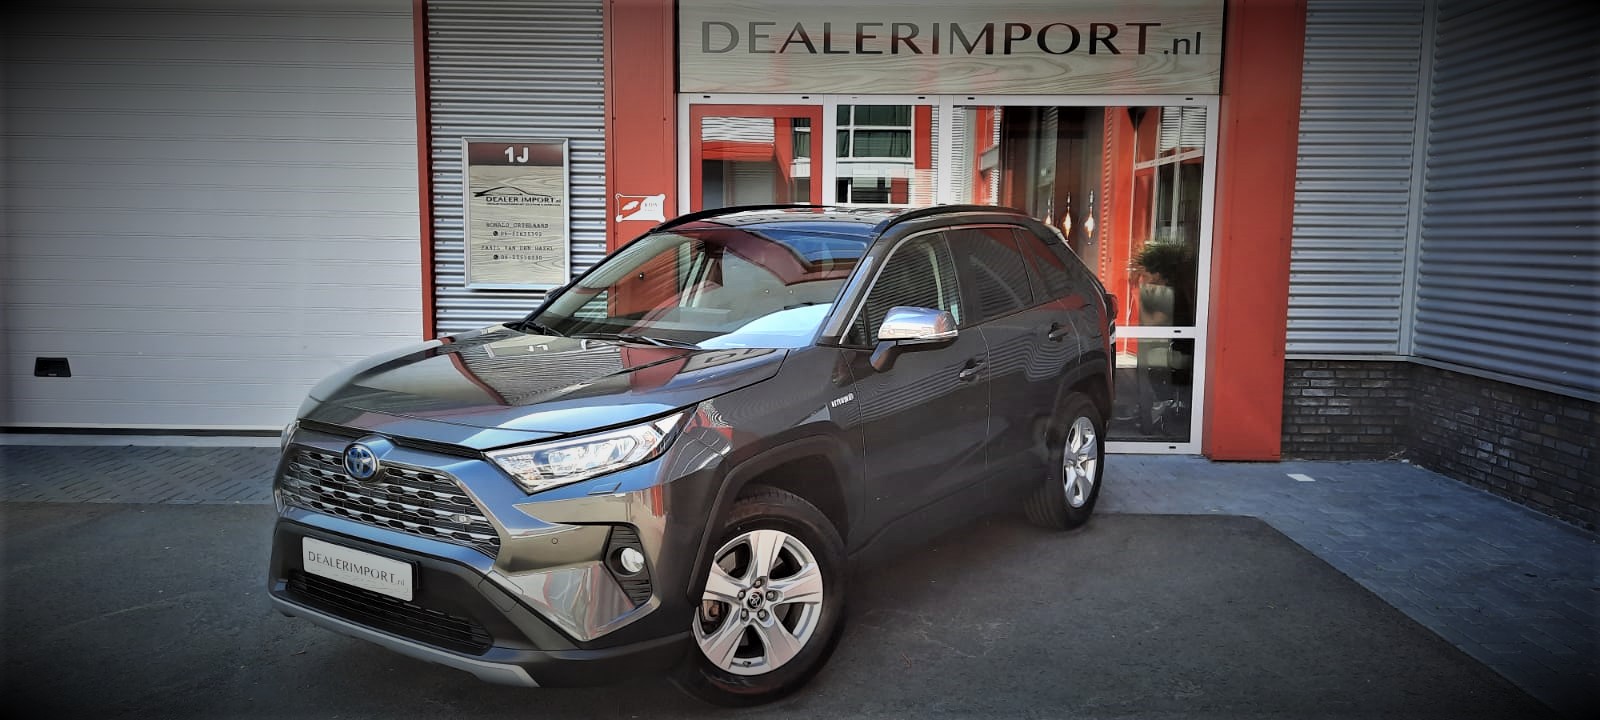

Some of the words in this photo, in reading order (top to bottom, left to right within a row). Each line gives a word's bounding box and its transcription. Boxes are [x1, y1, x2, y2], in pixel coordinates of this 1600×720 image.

[701, 21, 1201, 55] DEALERIMPORT.nl
[504, 146, 529, 163] 1J
[308, 551, 404, 586] DEALERIMPORT.nl
